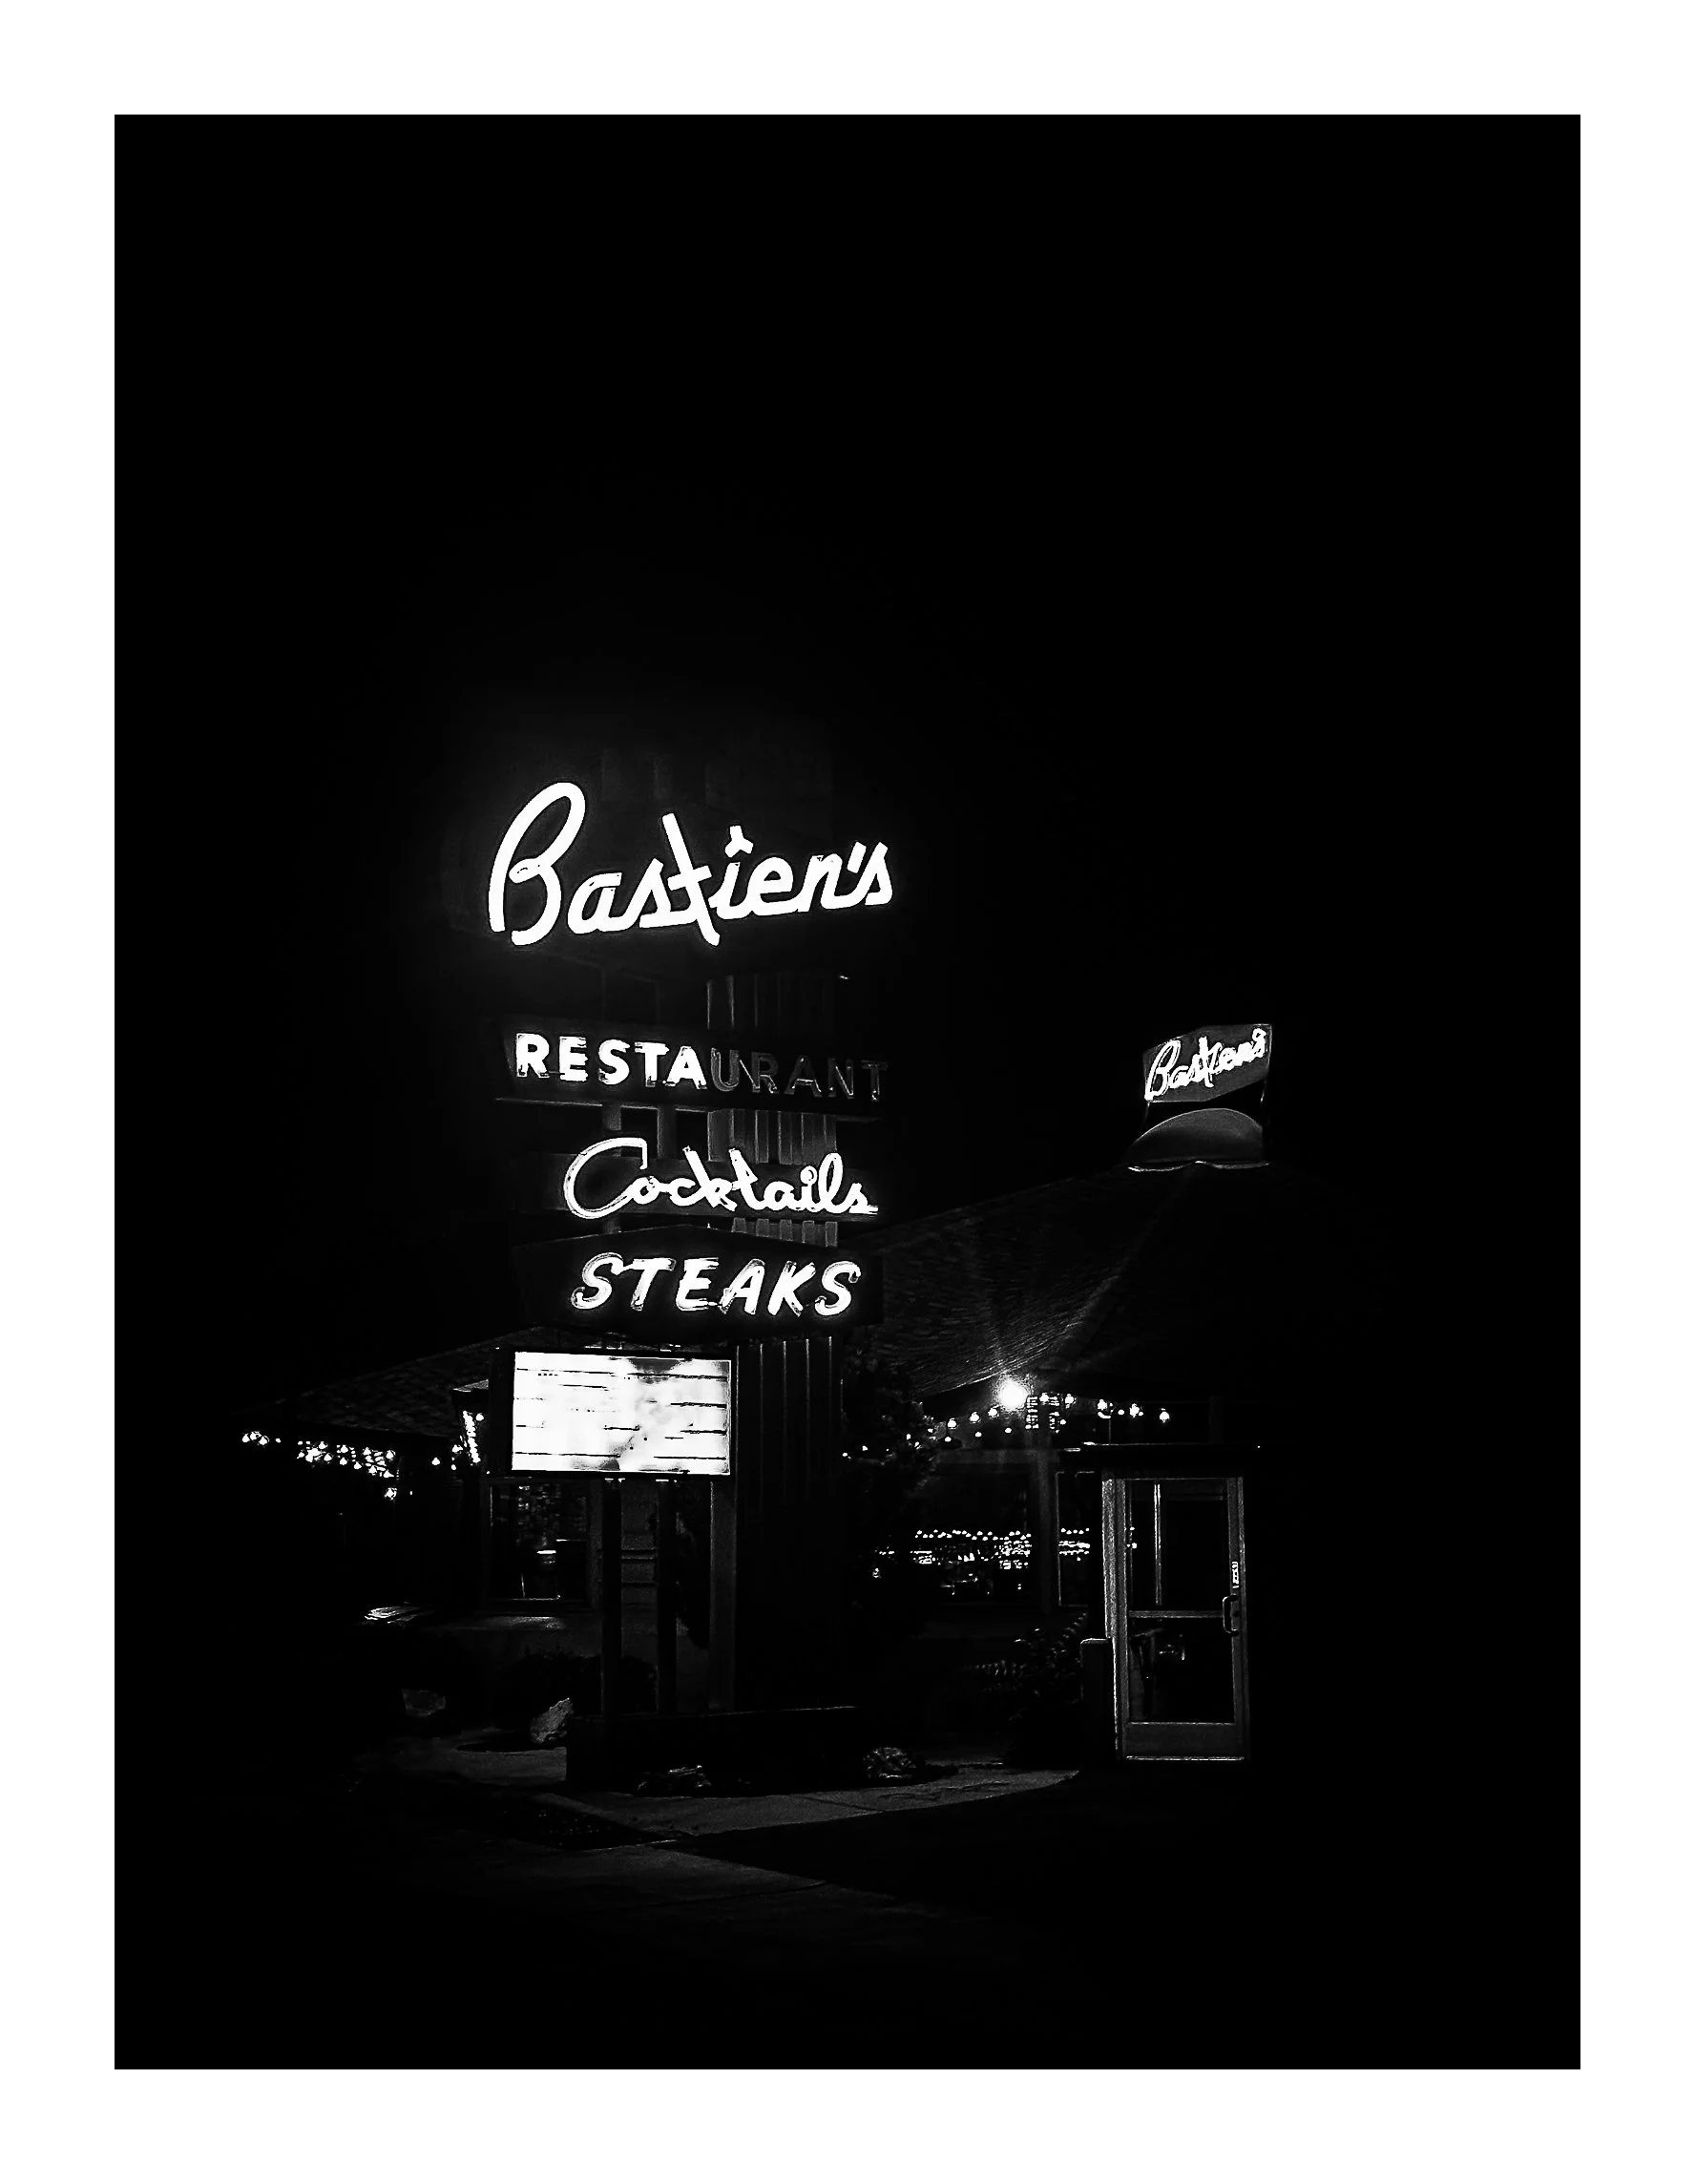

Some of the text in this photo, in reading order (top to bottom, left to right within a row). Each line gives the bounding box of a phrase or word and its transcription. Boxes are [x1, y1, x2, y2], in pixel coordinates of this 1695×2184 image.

[488, 782, 893, 946] Bastien's
[515, 1032, 890, 1102] RESTAURANT
[564, 1137, 879, 1220] Cocktails
[570, 1252, 862, 1316] STEAKS
